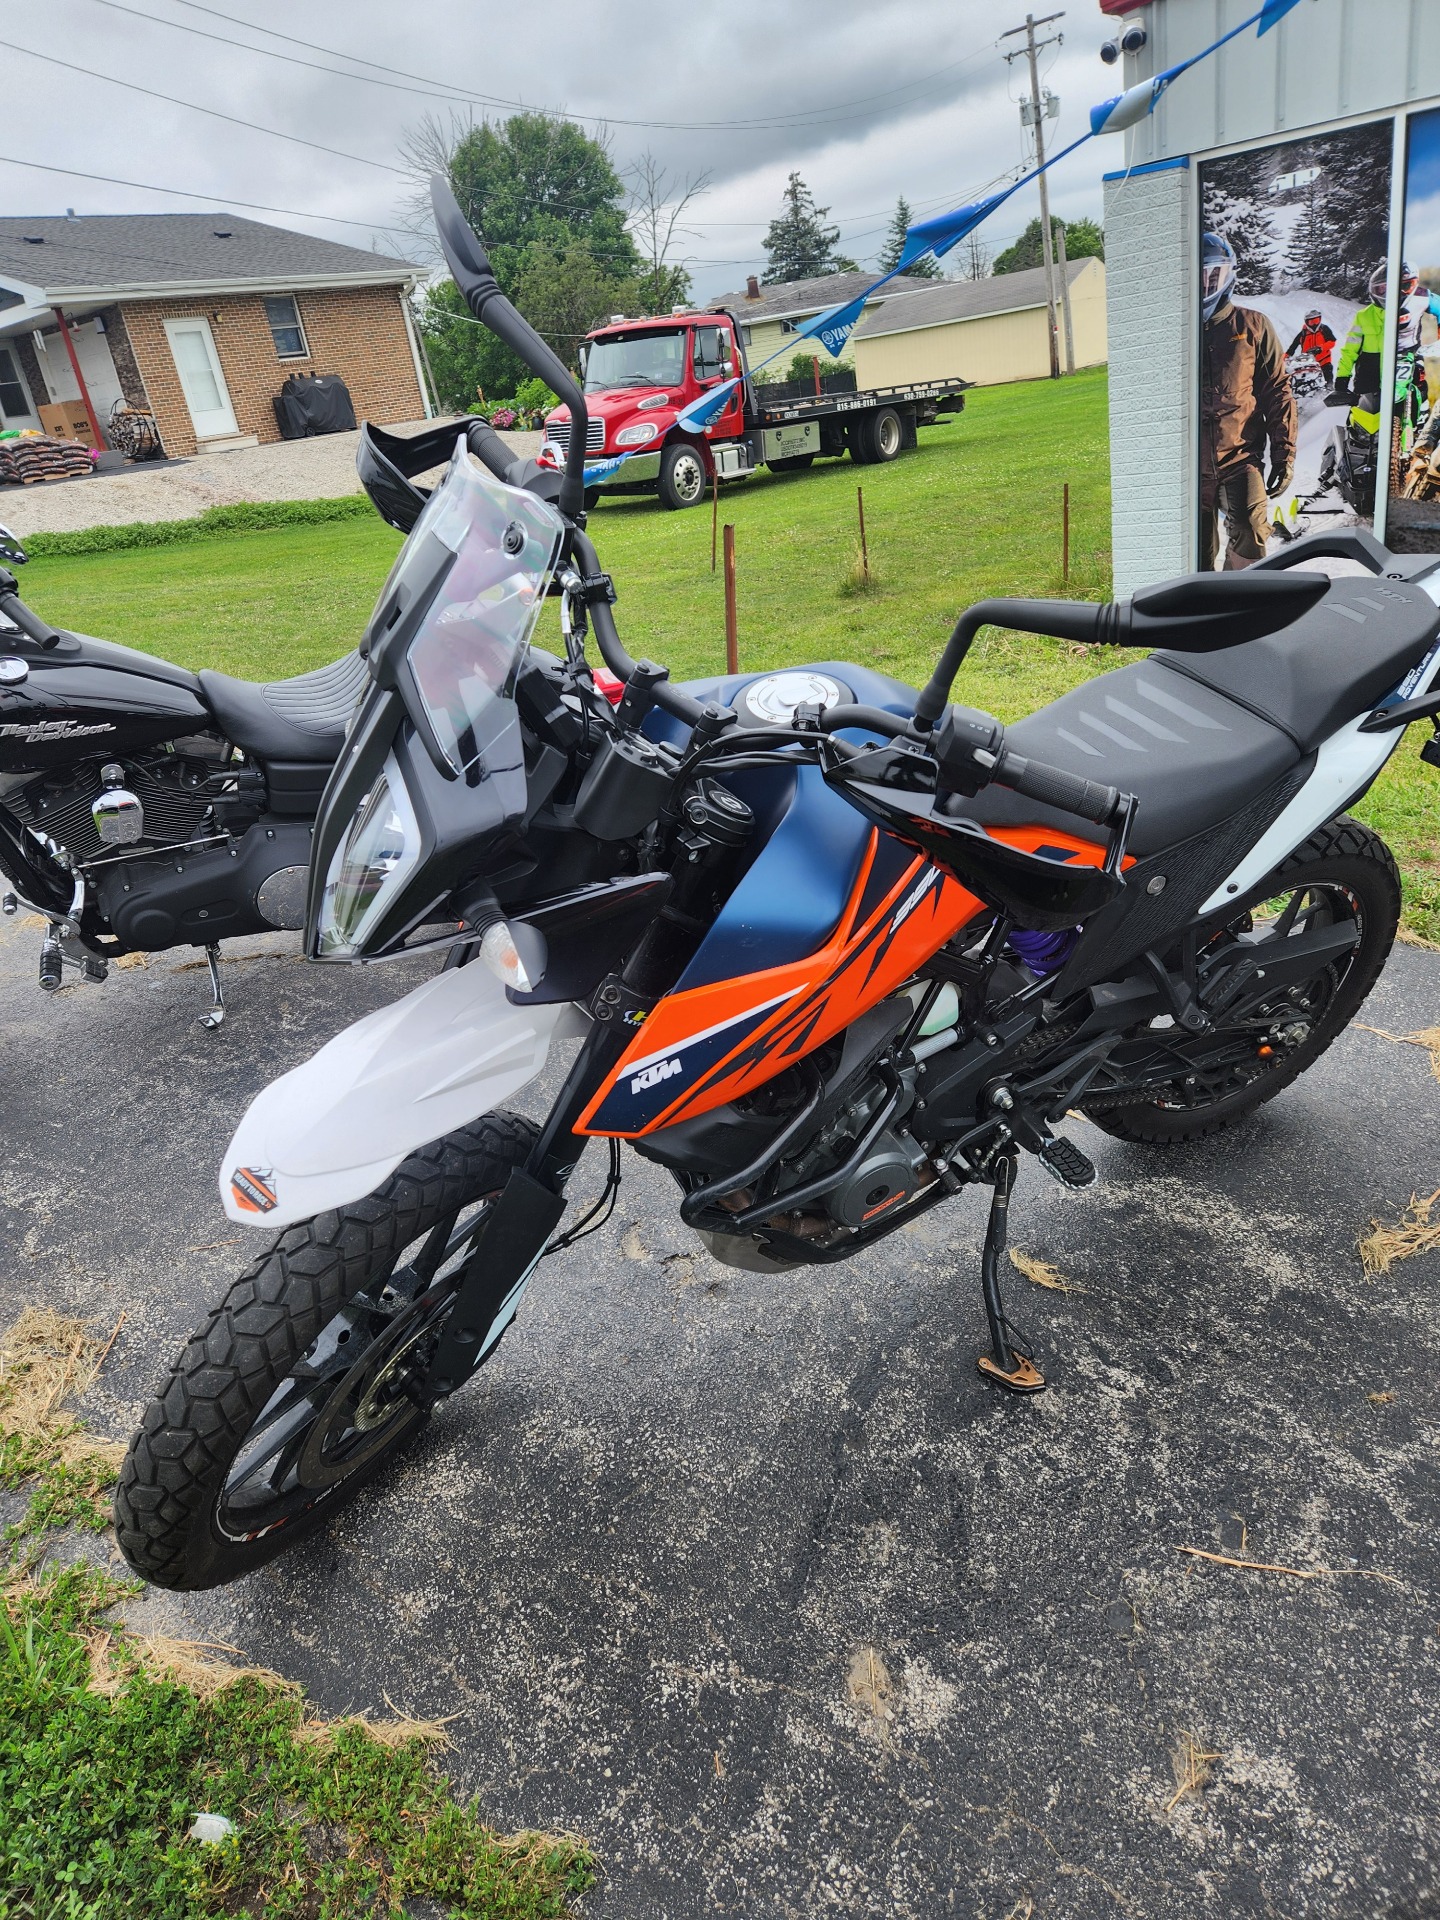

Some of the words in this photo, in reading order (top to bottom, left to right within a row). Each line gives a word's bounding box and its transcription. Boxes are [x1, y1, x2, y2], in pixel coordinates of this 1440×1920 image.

[1401, 651, 1433, 700] ADVENTURE
[20, 723, 117, 743] Davidson
[631, 1058, 683, 1095] KTM
